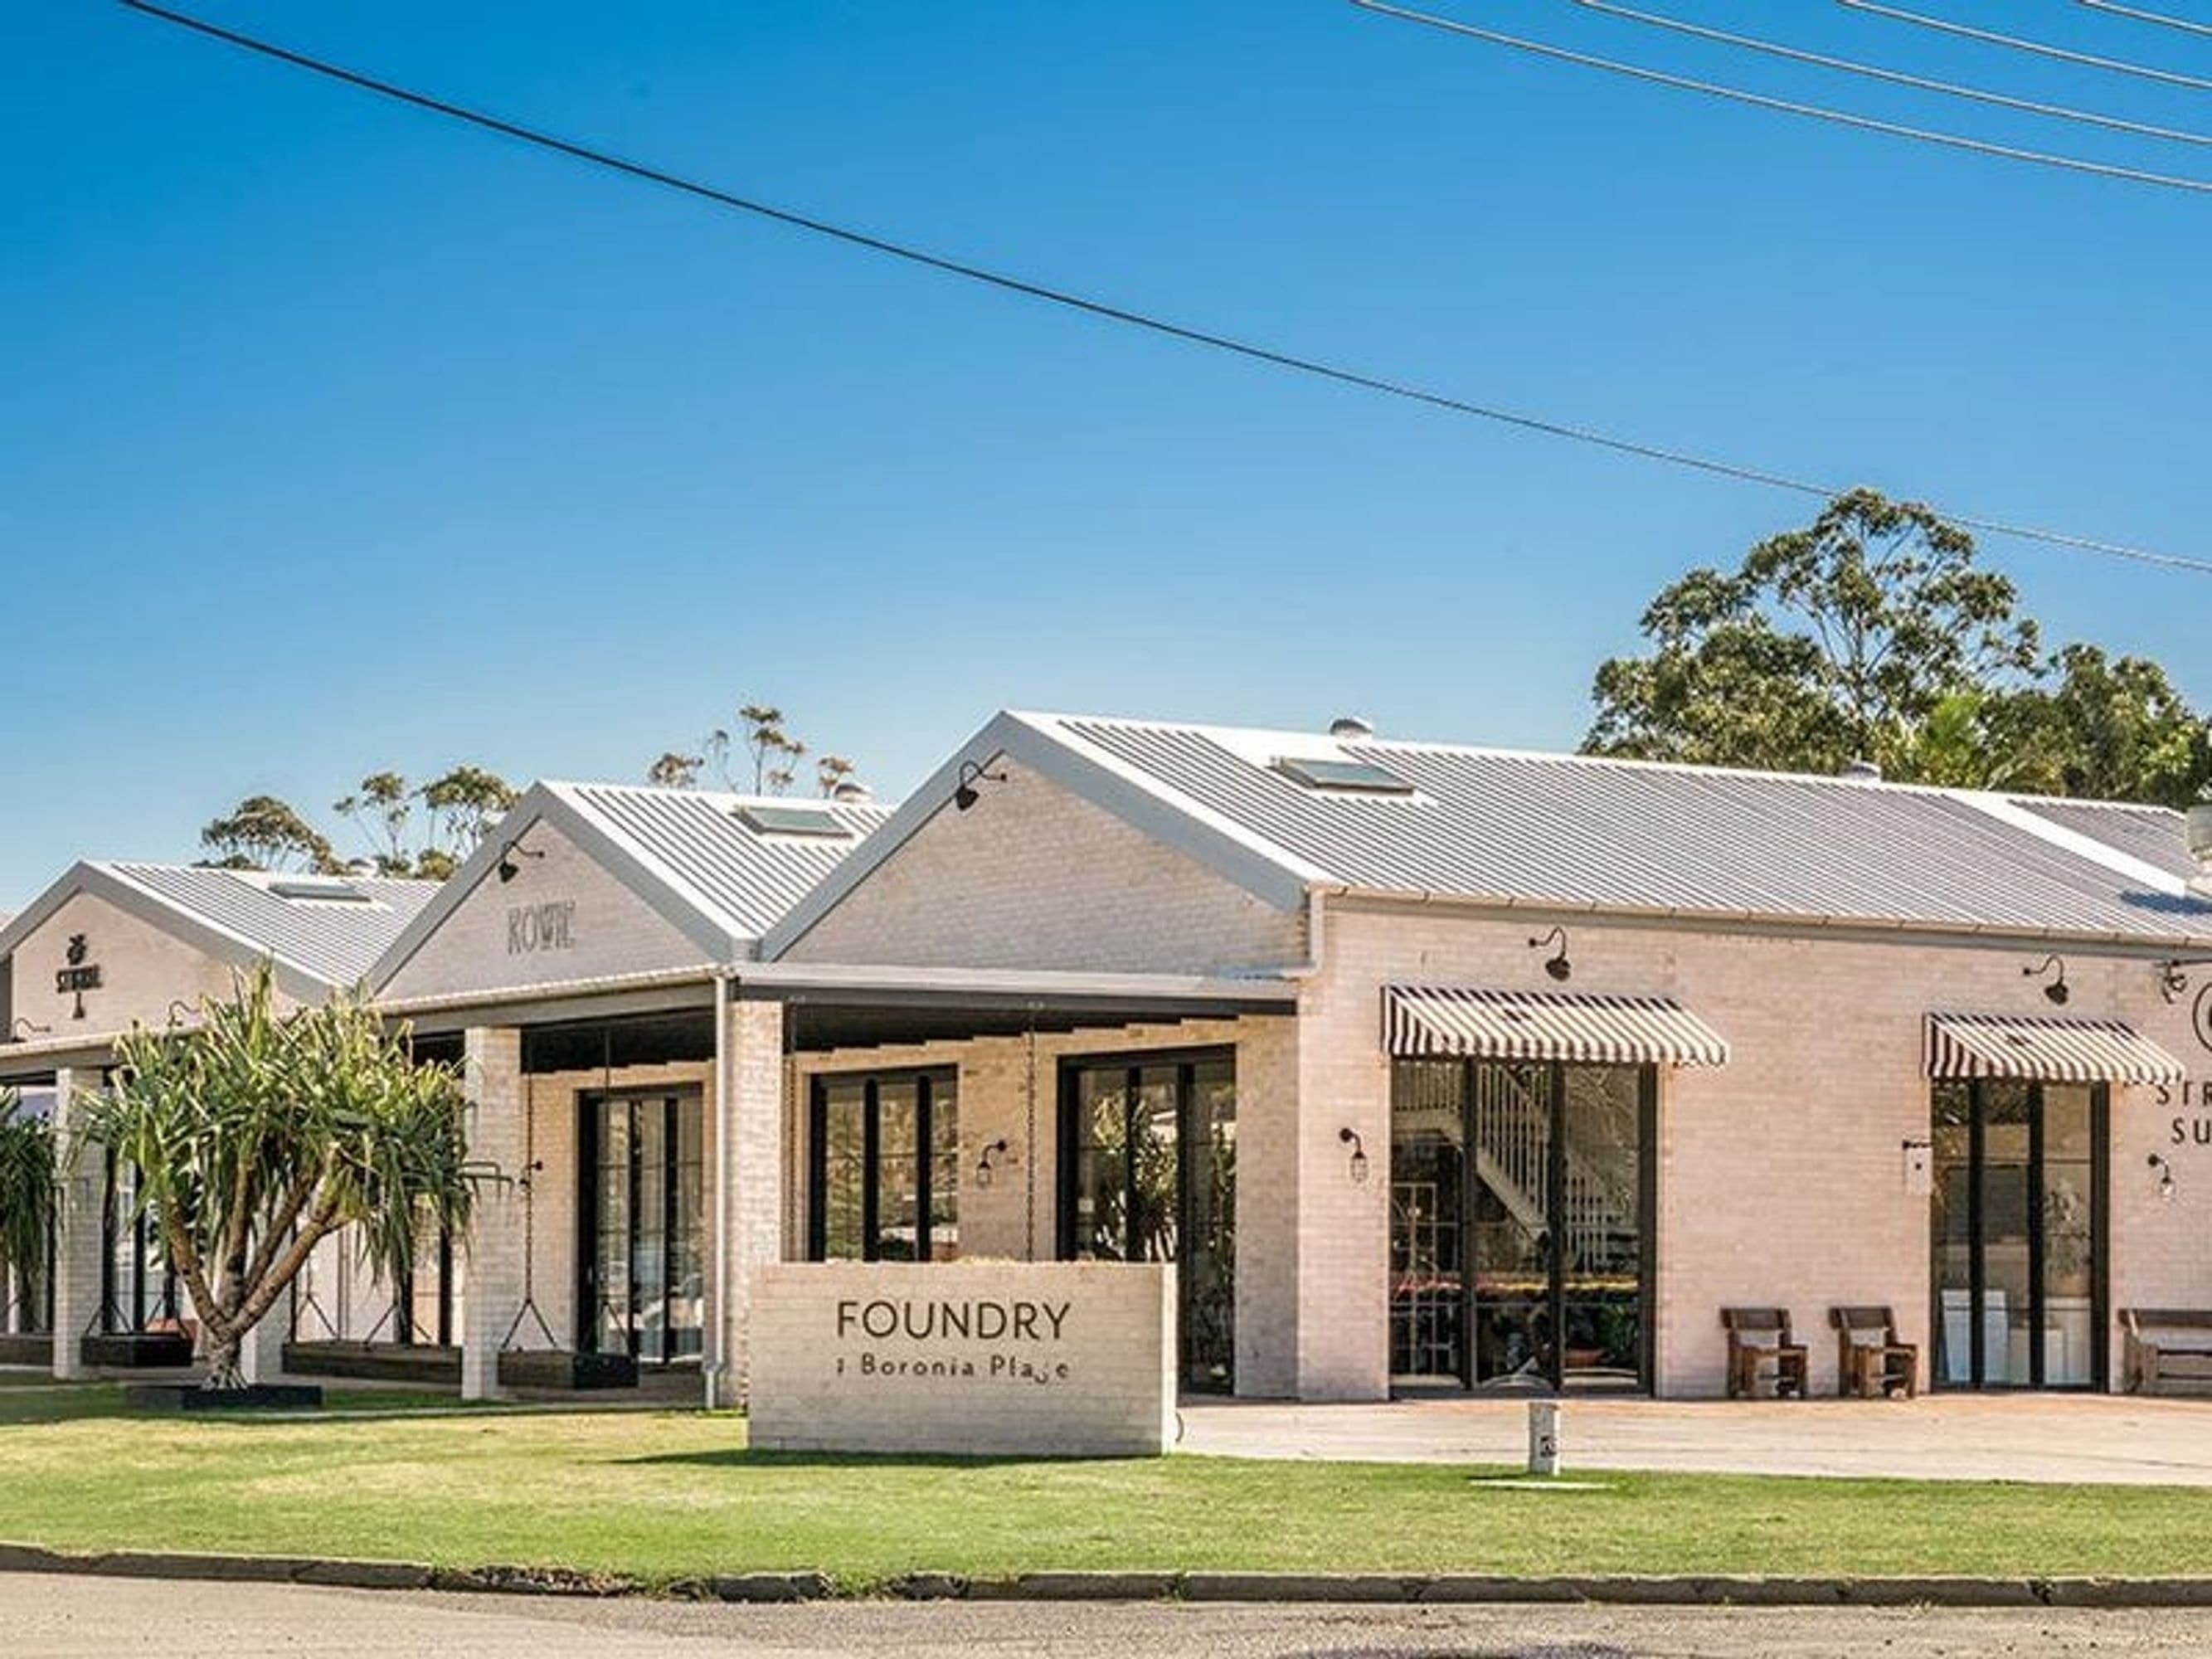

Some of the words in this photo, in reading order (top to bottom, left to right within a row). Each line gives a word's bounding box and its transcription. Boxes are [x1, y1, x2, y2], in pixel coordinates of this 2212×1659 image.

[2171, 1117, 2210, 1144] SU
[837, 1300, 1071, 1339] FOUNDRY
[862, 1352, 975, 1375] Boronia
